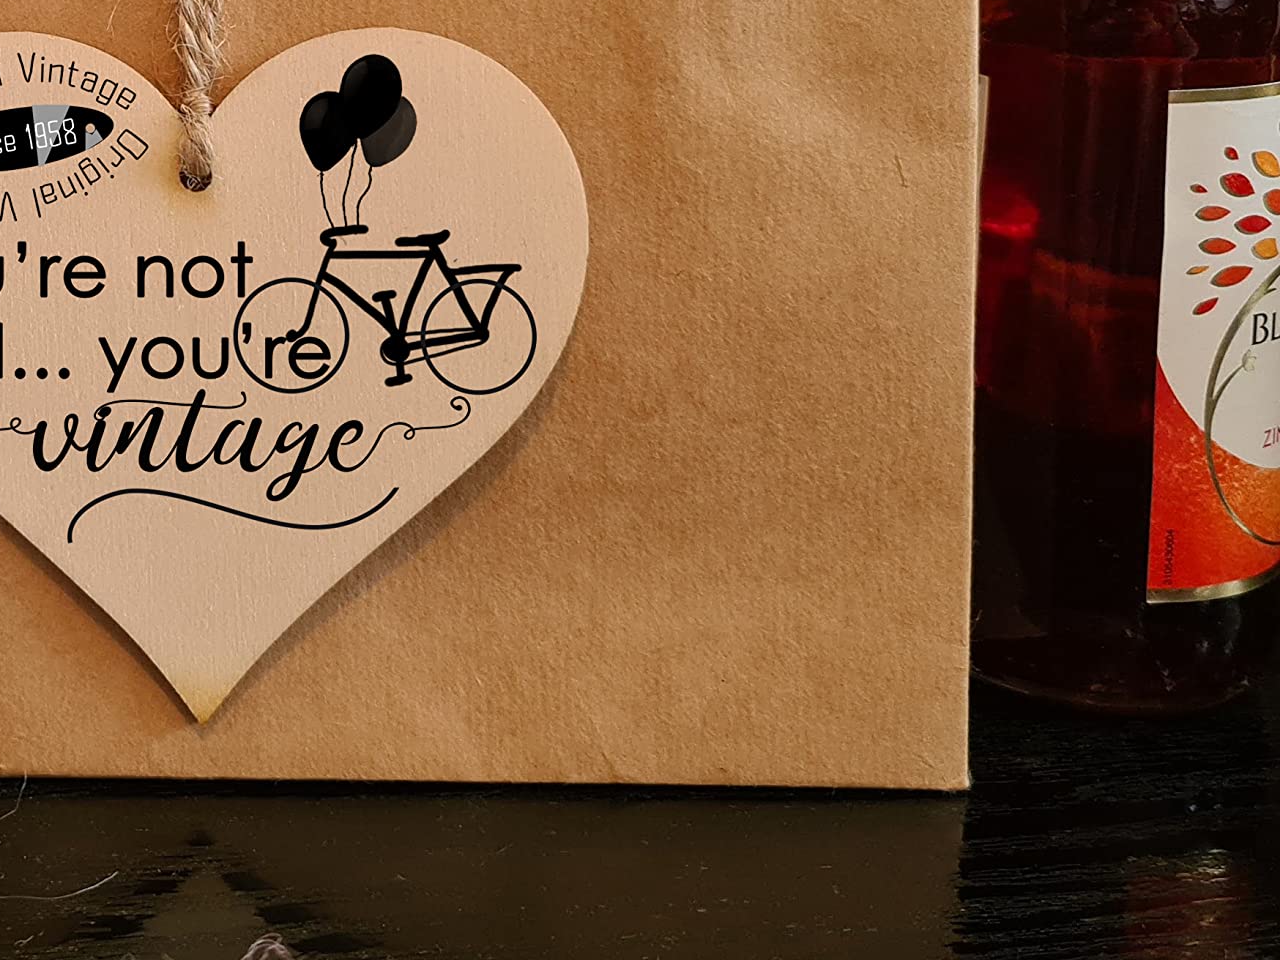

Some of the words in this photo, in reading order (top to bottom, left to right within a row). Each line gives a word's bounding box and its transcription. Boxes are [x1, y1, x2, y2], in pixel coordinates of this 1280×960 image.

[16, 51, 138, 111] Vintage
[24, 117, 78, 152] 1958
[31, 127, 150, 219] Original
[135, 240, 255, 300] not
[98, 326, 333, 393] you're
[18, 388, 392, 502] vintage
